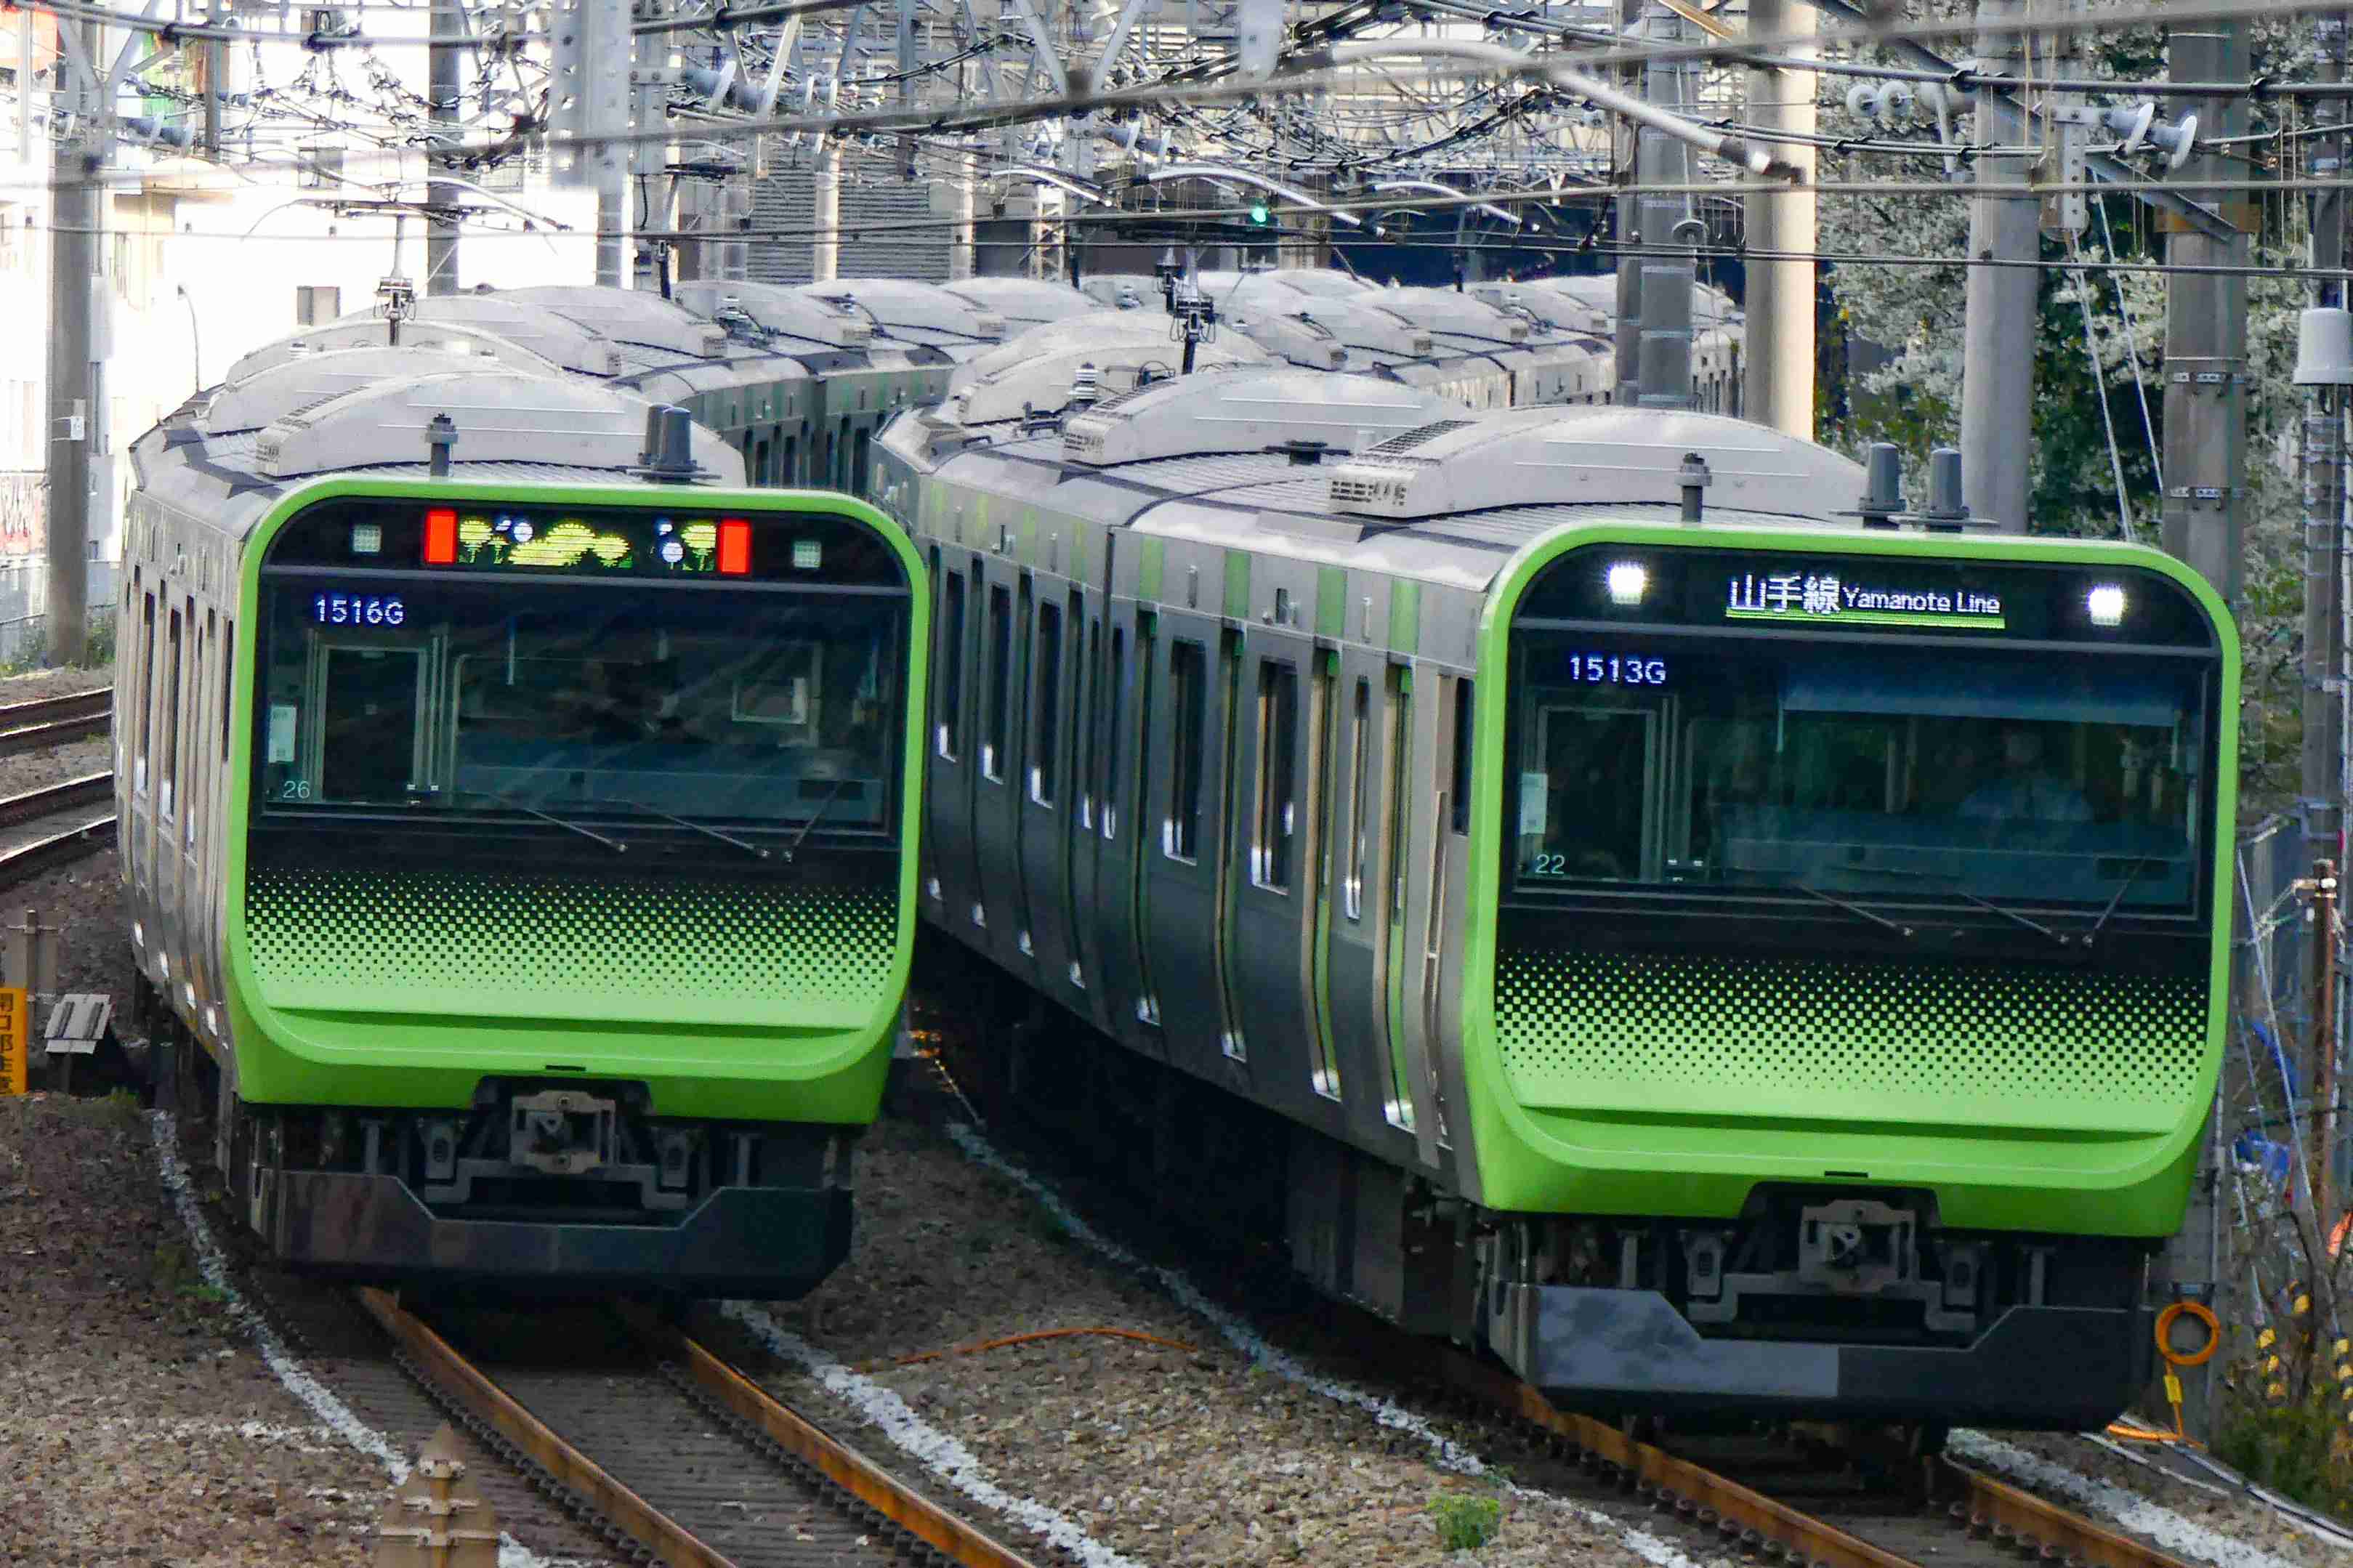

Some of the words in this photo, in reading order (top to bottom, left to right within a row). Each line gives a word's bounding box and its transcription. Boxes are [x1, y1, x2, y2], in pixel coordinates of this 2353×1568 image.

[1730, 573, 1841, 614] 山手線
[1842, 586, 1951, 612] Yamanote
[1956, 591, 2001, 614] Line
[316, 598, 404, 625] 1516G
[1570, 656, 1666, 684] 1513G
[283, 780, 311, 799] 26
[1535, 854, 1565, 874] 22
